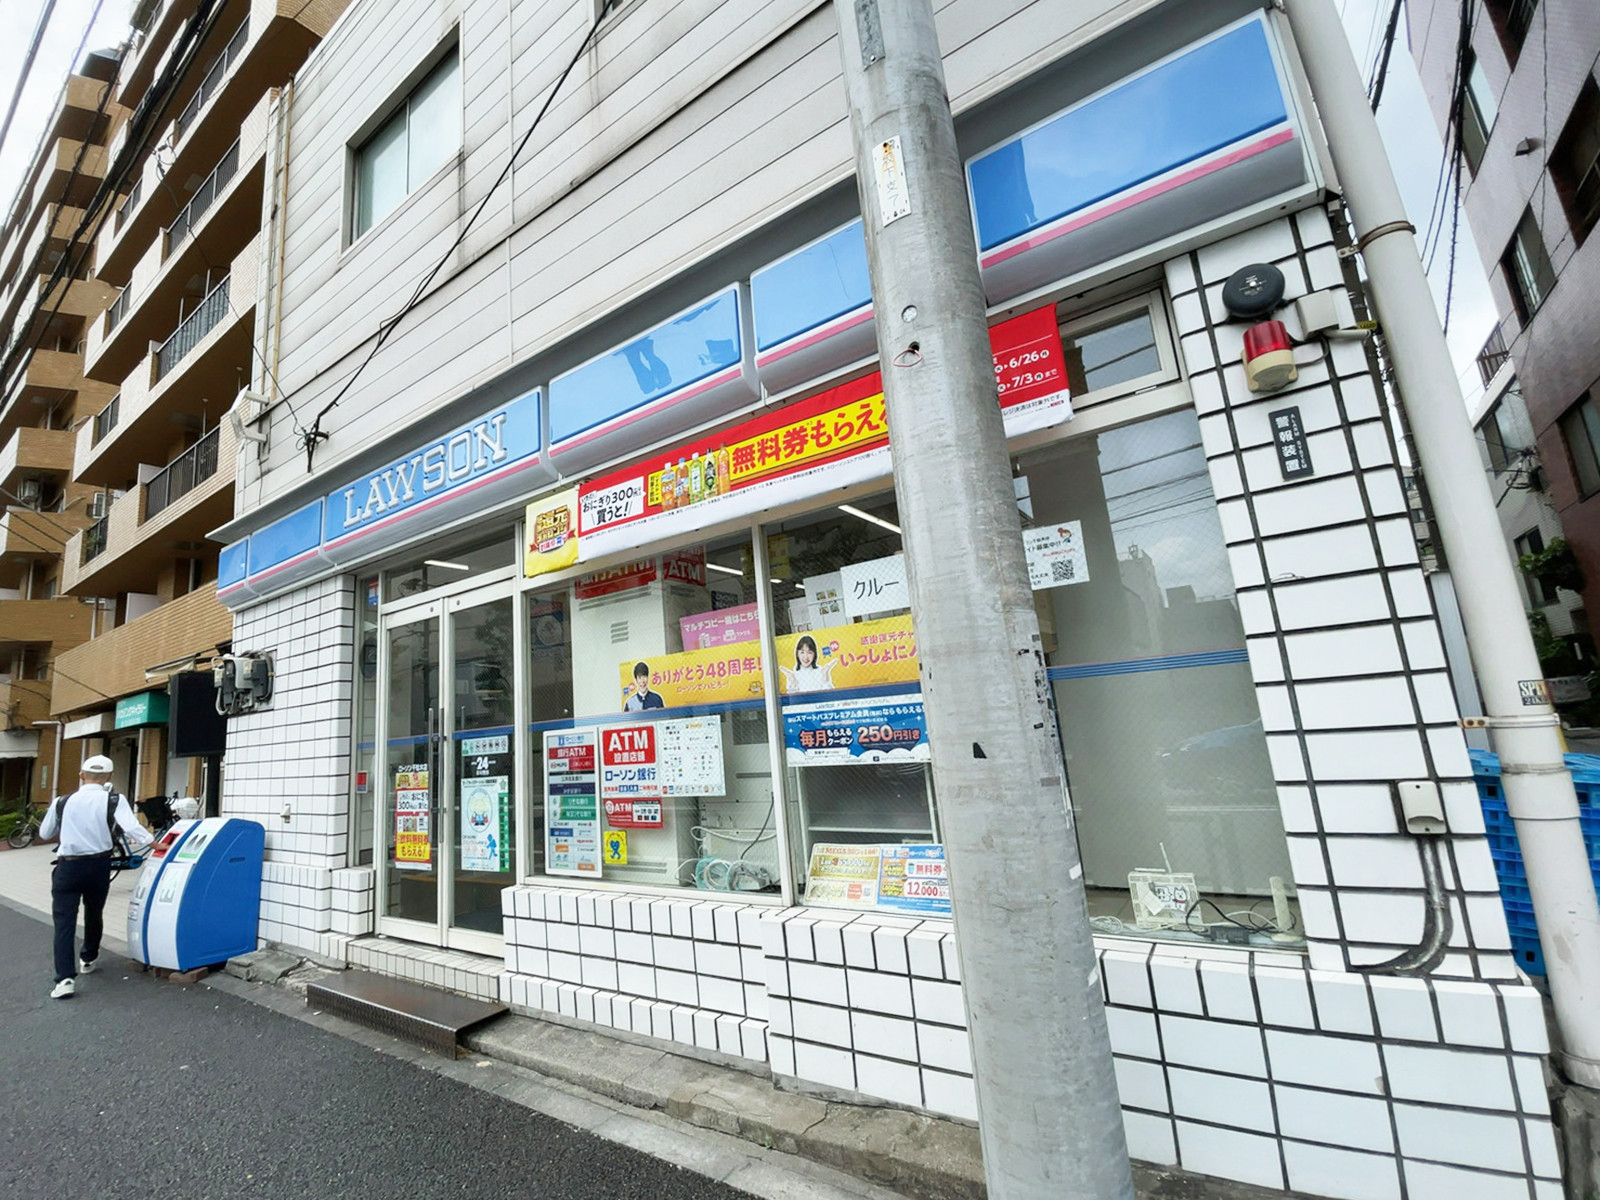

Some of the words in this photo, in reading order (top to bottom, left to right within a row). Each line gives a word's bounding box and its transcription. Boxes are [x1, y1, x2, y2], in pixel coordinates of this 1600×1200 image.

[1275, 415, 1301, 473] 警報装置
[343, 411, 508, 529] LAWSON
[668, 558, 700, 581] ATM
[608, 729, 649, 752] ATM
[800, 729, 828, 748] 毎月
[476, 756, 489, 770] 24
[615, 802, 633, 812] ATM
